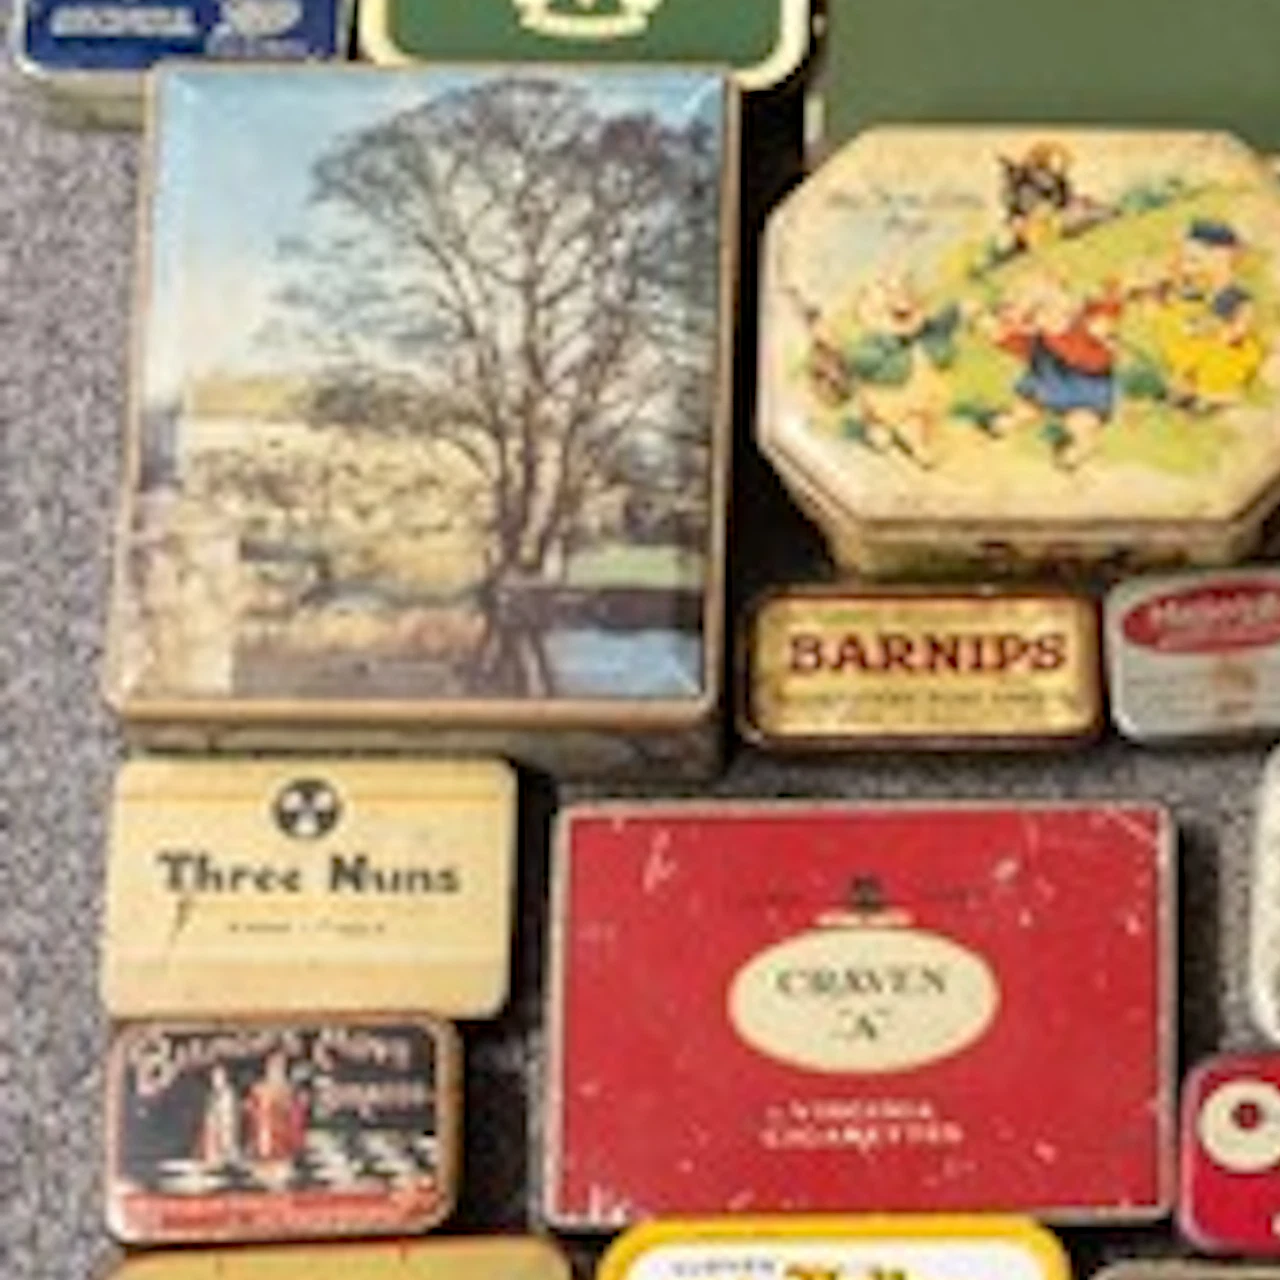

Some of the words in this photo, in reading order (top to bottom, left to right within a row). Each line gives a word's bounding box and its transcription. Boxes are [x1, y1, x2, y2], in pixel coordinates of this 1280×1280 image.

[790, 631, 1069, 676] BARNIPS
[157, 851, 300, 894] Three
[329, 854, 462, 894] Nuns
[776, 967, 948, 1000] CRAVEN
